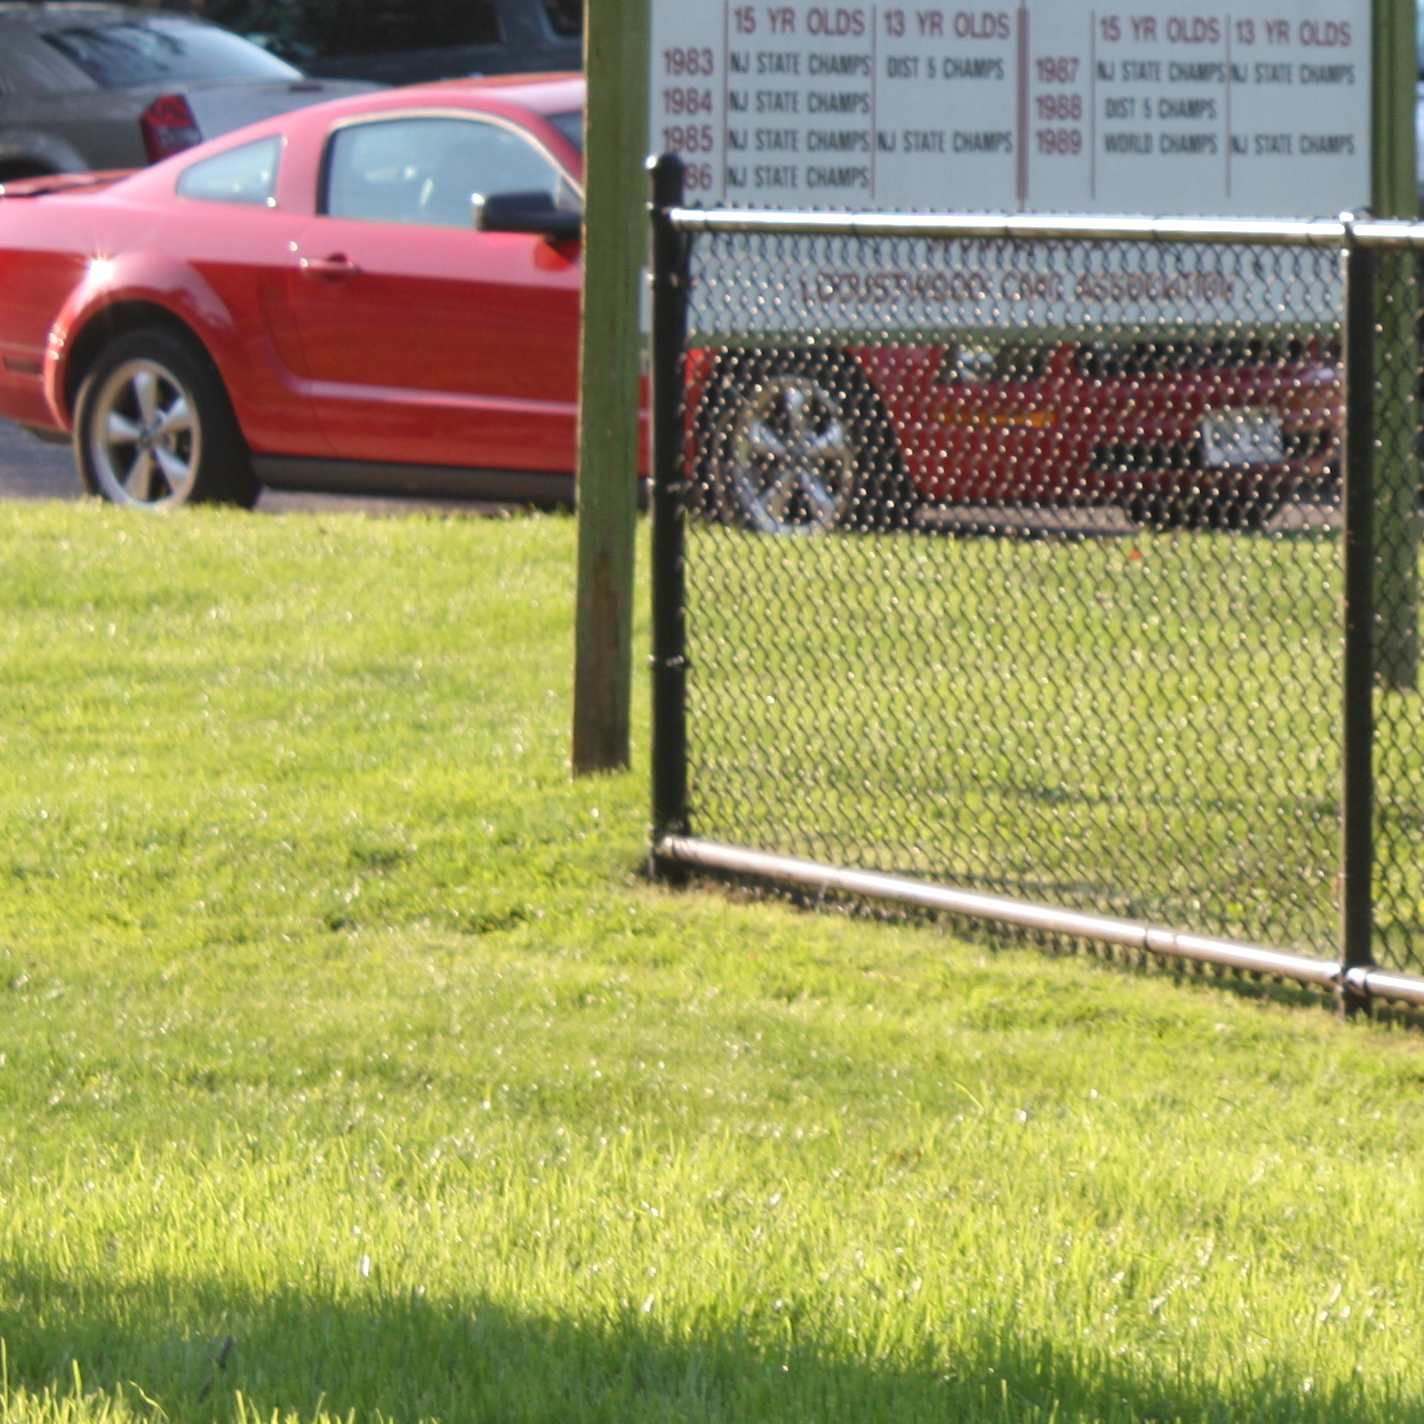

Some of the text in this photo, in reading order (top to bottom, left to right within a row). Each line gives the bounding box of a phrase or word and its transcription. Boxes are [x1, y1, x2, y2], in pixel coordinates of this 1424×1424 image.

[733, 6, 866, 38] 15 YR OLDS
[884, 9, 1011, 40] 13 YR OLDS
[1100, 15, 1221, 46] 15 YR OLDS
[1235, 19, 1353, 48] 13 YR OLDS
[663, 48, 715, 76] 1983
[729, 50, 872, 78] NJ STATE CHAMPS
[886, 56, 919, 79] DIST
[943, 56, 1005, 81] CHAMPS
[1035, 57, 1081, 84] 1987
[1097, 59, 1226, 85] NJ STATE CHAMPS
[1230, 62, 1356, 87] NJ STATE CHAMPS
[663, 89, 713, 116] 1984
[728, 89, 871, 116] NJ STATE CHAMPS
[1105, 96, 1136, 121] DIST
[1158, 97, 1217, 122] CHAMPS
[663, 125, 714, 155] 1985
[728, 127, 871, 155] NJ STATE CHAMPS
[877, 130, 1014, 156] NJ STATE CHAMPS
[1035, 129, 1083, 157] 1989
[1103, 132, 1218, 157] WORLD CHAMPS
[1230, 132, 1356, 157] NJ STATE CHAMPS
[727, 163, 871, 190] NJ STATE CHAMPS
